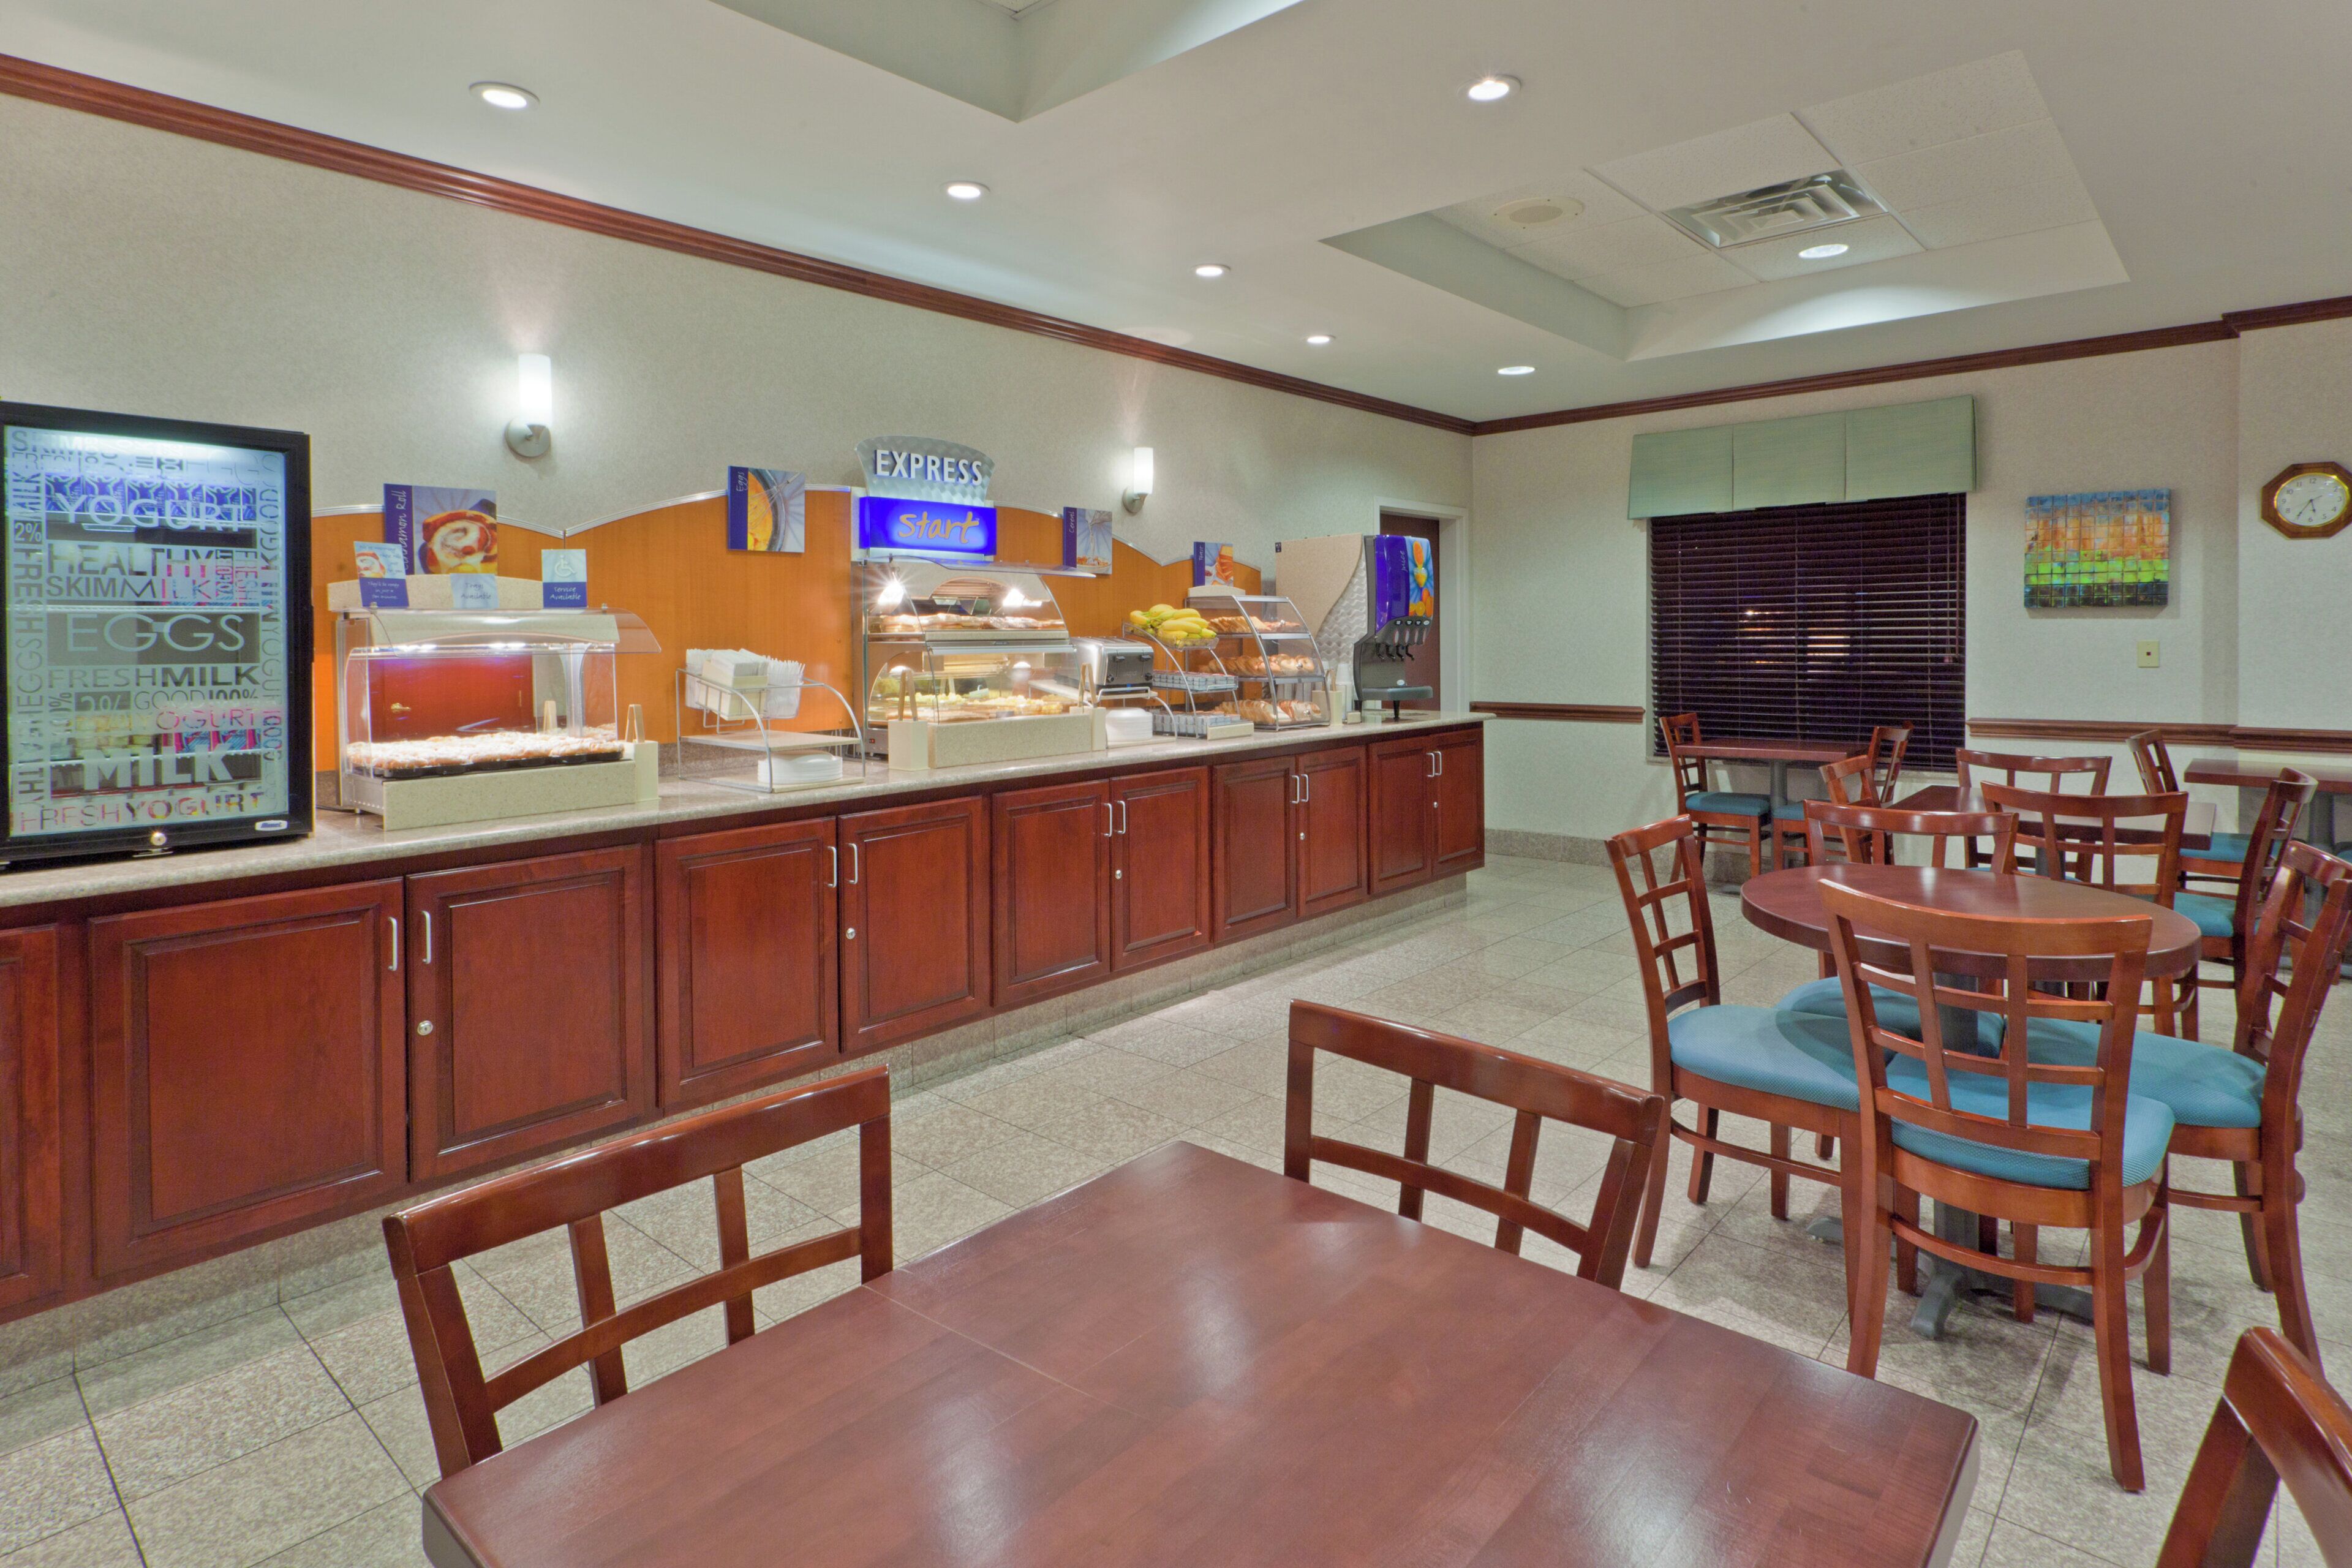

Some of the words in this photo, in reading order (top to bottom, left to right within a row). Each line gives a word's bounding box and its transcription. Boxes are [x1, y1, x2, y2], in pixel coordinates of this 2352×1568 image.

[736, 471, 748, 491] Eggs
[875, 450, 982, 485] EXPRESS
[55, 492, 247, 532] YOGURT
[391, 490, 407, 510] Roll
[15, 522, 42, 543] 2%
[899, 511, 979, 543] Start
[48, 543, 214, 578] HEALTHY
[46, 575, 116, 598] SKIM
[67, 612, 245, 652] EGGS
[15, 638, 43, 707] EGGS
[48, 668, 157, 688] FRESH
[161, 666, 260, 687] MILK
[83, 743, 234, 791] MILK
